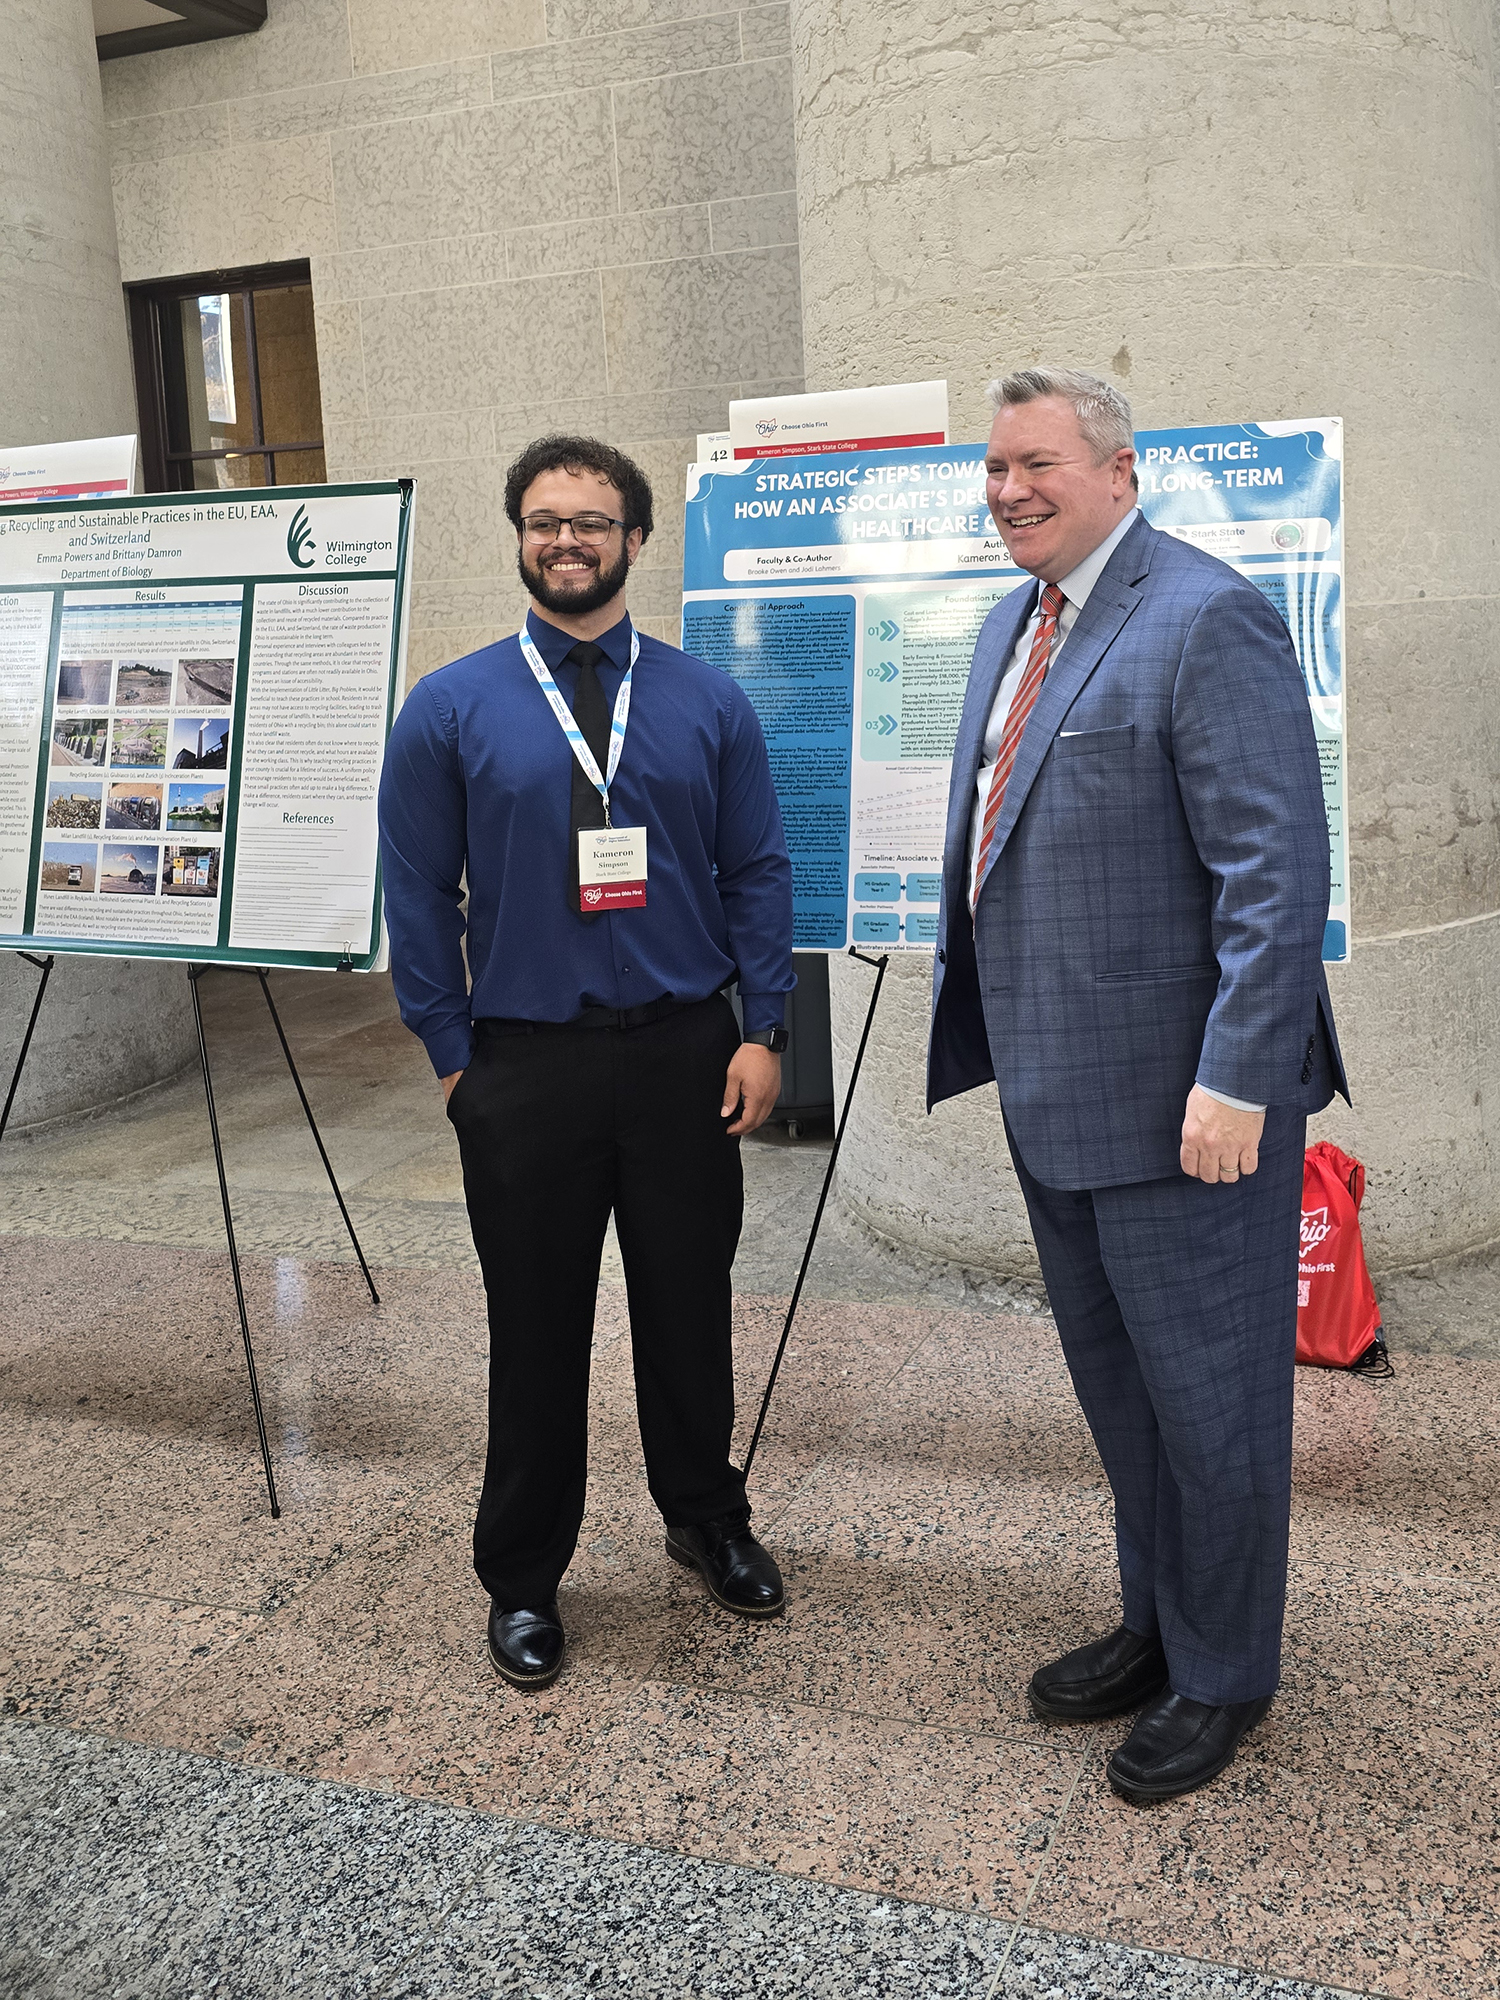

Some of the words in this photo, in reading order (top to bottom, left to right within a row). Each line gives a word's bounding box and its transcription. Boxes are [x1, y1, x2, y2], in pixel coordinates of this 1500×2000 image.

[756, 422, 778, 436] Ohio
[781, 447, 806, 455] Simpson,
[837, 442, 858, 451] College
[1145, 441, 1258, 466] PRACTICE:
[710, 450, 728, 462] 42
[755, 469, 859, 493] STRATEGIC
[862, 464, 922, 485] STEPS
[926, 460, 988, 480] TOWA
[1150, 467, 1284, 494] LONG-TERM
[734, 499, 781, 519] HOW
[786, 498, 816, 516] AN
[820, 489, 948, 514] ASSOCIATE'S
[9, 518, 55, 533] Recycling
[58, 515, 76, 528] and
[79, 512, 139, 527] Sustainable
[142, 510, 190, 523] Practices
[194, 508, 204, 521] in
[207, 507, 225, 520] the
[228, 506, 247, 520] EU,
[251, 505, 278, 518] EAA,
[852, 514, 979, 538] HEALTHCARE
[68, 533, 88, 546] and
[90, 530, 150, 545] Switzerland
[1191, 530, 1217, 538] Stark
[1219, 528, 1246, 537] State
[326, 541, 392, 555] Wilmington
[983, 540, 1005, 548] Auth
[37, 554, 62, 563] Emma
[64, 552, 93, 562] Powers
[95, 550, 110, 560] and
[112, 550, 146, 561] Brittany
[147, 548, 182, 558] Damron
[325, 554, 367, 566] College
[757, 557, 784, 565] Faculty
[793, 554, 832, 562] Co-Author
[958, 554, 1000, 563] Kameron
[61, 569, 110, 581] Department
[112, 567, 120, 578] of
[122, 567, 153, 579] Biology
[299, 584, 348, 596] Discussion
[1256, 580, 1285, 589] nalysis
[135, 590, 166, 601] Results
[945, 594, 990, 603] Foundation
[768, 602, 805, 612] Approach
[868, 627, 879, 636] 01
[867, 668, 880, 678] 02
[865, 721, 878, 730] 03
[283, 812, 334, 824] References
[593, 850, 634, 858] Kameron
[1300, 1217, 1331, 1242] hio
[1316, 1262, 1336, 1272] First
